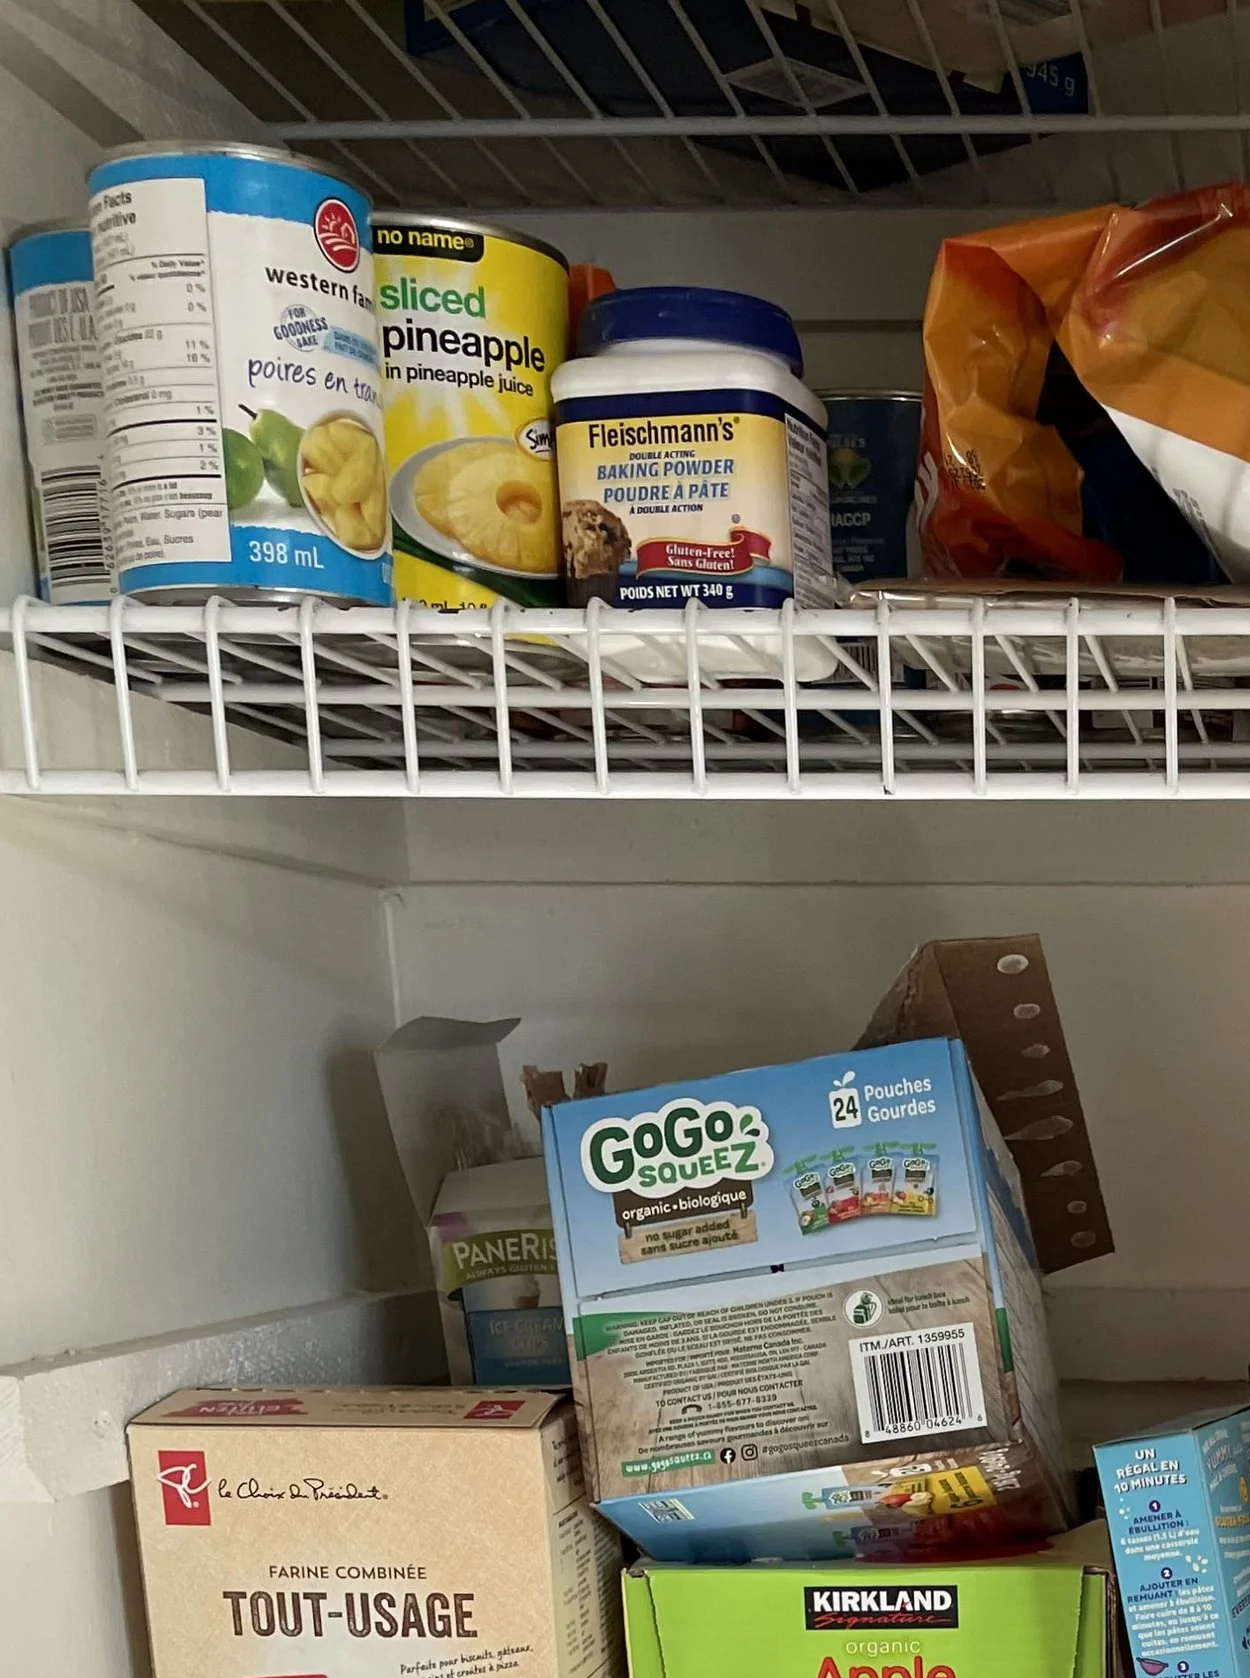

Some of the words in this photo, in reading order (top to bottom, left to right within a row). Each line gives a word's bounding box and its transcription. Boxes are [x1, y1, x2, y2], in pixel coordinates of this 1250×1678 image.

[377, 229, 403, 245] no
[265, 267, 349, 301] western
[380, 276, 487, 319] sliced
[288, 307, 307, 321] FOR
[273, 317, 329, 340] GOODNESS
[296, 335, 319, 348] SAKE
[382, 318, 546, 373] pineapple
[248, 357, 317, 388] poires
[325, 371, 348, 394] en
[385, 362, 402, 380] in
[406, 363, 495, 389] pineapple
[497, 373, 534, 397] juice
[589, 416, 736, 449] Fleischmann's
[629, 451, 663, 461] DOUBLE
[664, 449, 696, 460] ACTING
[597, 461, 660, 481] BAKING
[663, 458, 735, 477] POWDER
[603, 484, 670, 504] POUDRE
[674, 480, 684, 500] À
[688, 479, 730, 499] PÂTE
[636, 504, 670, 515] DOUBLE
[671, 503, 704, 514] ACTION
[249, 541, 288, 564] 398
[295, 544, 324, 568] mL
[665, 544, 735, 560] Gluten-Free!
[667, 556, 693, 569] Sans
[695, 558, 735, 571] Gluten!
[620, 585, 654, 600] POIDS
[656, 585, 678, 599] NET
[679, 584, 701, 597] WT
[702, 583, 722, 597] 340
[726, 585, 734, 600] g
[863, 1077, 932, 1101] Pouches
[832, 1095, 859, 1122] 24
[867, 1098, 937, 1123] Gourdes
[645, 1233, 660, 1243] no
[663, 1227, 693, 1243] sugar
[695, 1219, 731, 1234] added
[640, 1245, 667, 1257] sans
[669, 1239, 700, 1251] sucre
[701, 1229, 739, 1248] ajouté
[917, 1328, 966, 1345] 1359955
[666, 1394, 702, 1407] CONTACT
[717, 1388, 736, 1399] POUR
[737, 1386, 759, 1397] NOUS
[759, 1379, 804, 1393] CONTACTER
[885, 1420, 922, 1435] 48860
[926, 1416, 962, 1430] 04624
[762, 1434, 850, 1456] #gogosqueezcanada
[1134, 1447, 1157, 1460] UN
[1115, 1462, 1159, 1480] RÉGAL
[1160, 1460, 1180, 1472] EN
[236, 1477, 286, 1500] Choix
[1113, 1481, 1130, 1494] 10
[1131, 1473, 1188, 1491] MINUTES
[1128, 1520, 1185, 1535] ÉBULLITION
[1133, 1511, 1173, 1525] AMENER
[269, 1565, 330, 1580] FARINE
[335, 1561, 427, 1580] COMBINÉE
[1139, 1579, 1184, 1593] AJOUTER
[1185, 1577, 1199, 1586] EN
[812, 1590, 953, 1613] KIRKLAND
[1127, 1590, 1173, 1604] REMUANT
[222, 1590, 478, 1639] TOUT-USAGE
[814, 1611, 952, 1629] Signature
[845, 1638, 922, 1658] organic
[400, 1659, 438, 1676] Parfaite
[439, 1657, 459, 1671] pour
[460, 1649, 495, 1665] biscuits,
[497, 1643, 535, 1660] gâteaux,
[456, 1665, 487, 1678] croûtes
[496, 1660, 520, 1675] pizza
